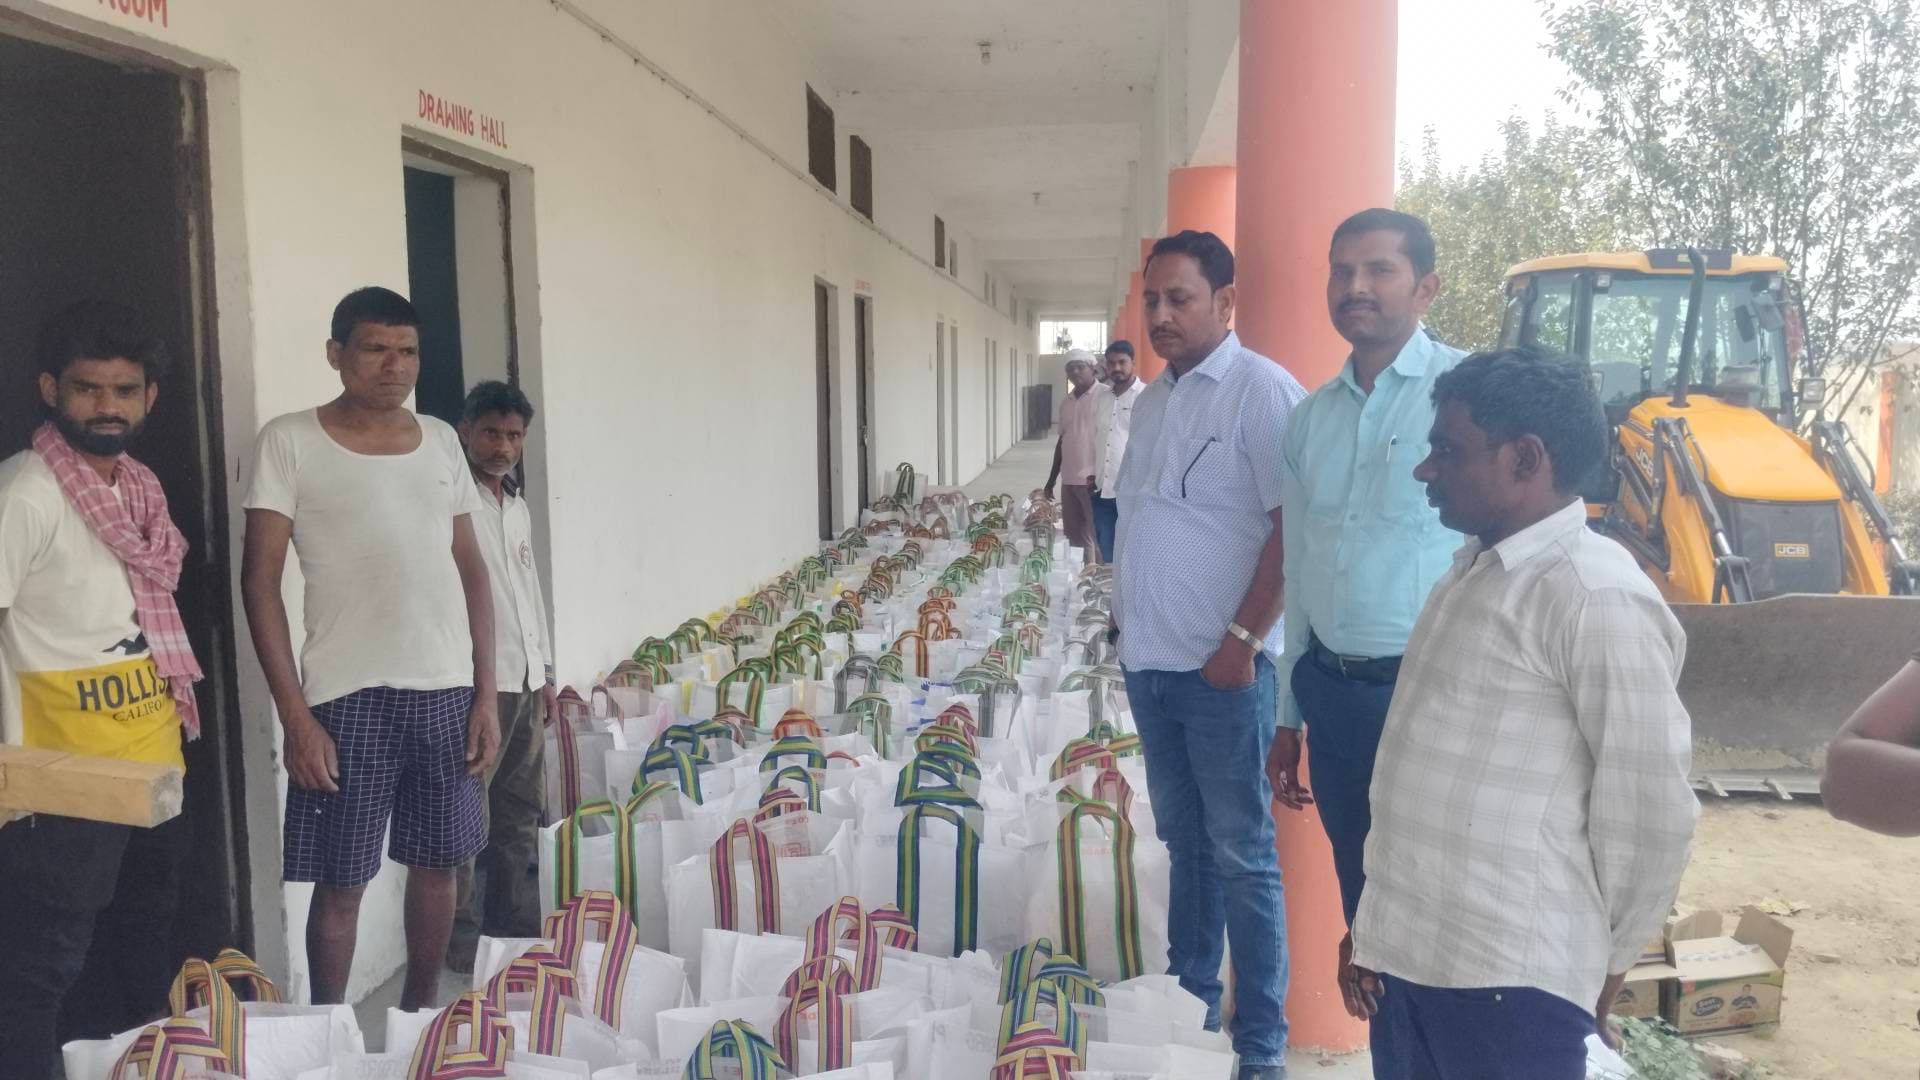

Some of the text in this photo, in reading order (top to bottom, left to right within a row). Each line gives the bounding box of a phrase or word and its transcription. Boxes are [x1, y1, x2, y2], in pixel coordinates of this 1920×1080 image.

[418, 88, 508, 149] DRAWING HALL
[1777, 545, 1807, 555] JCB
